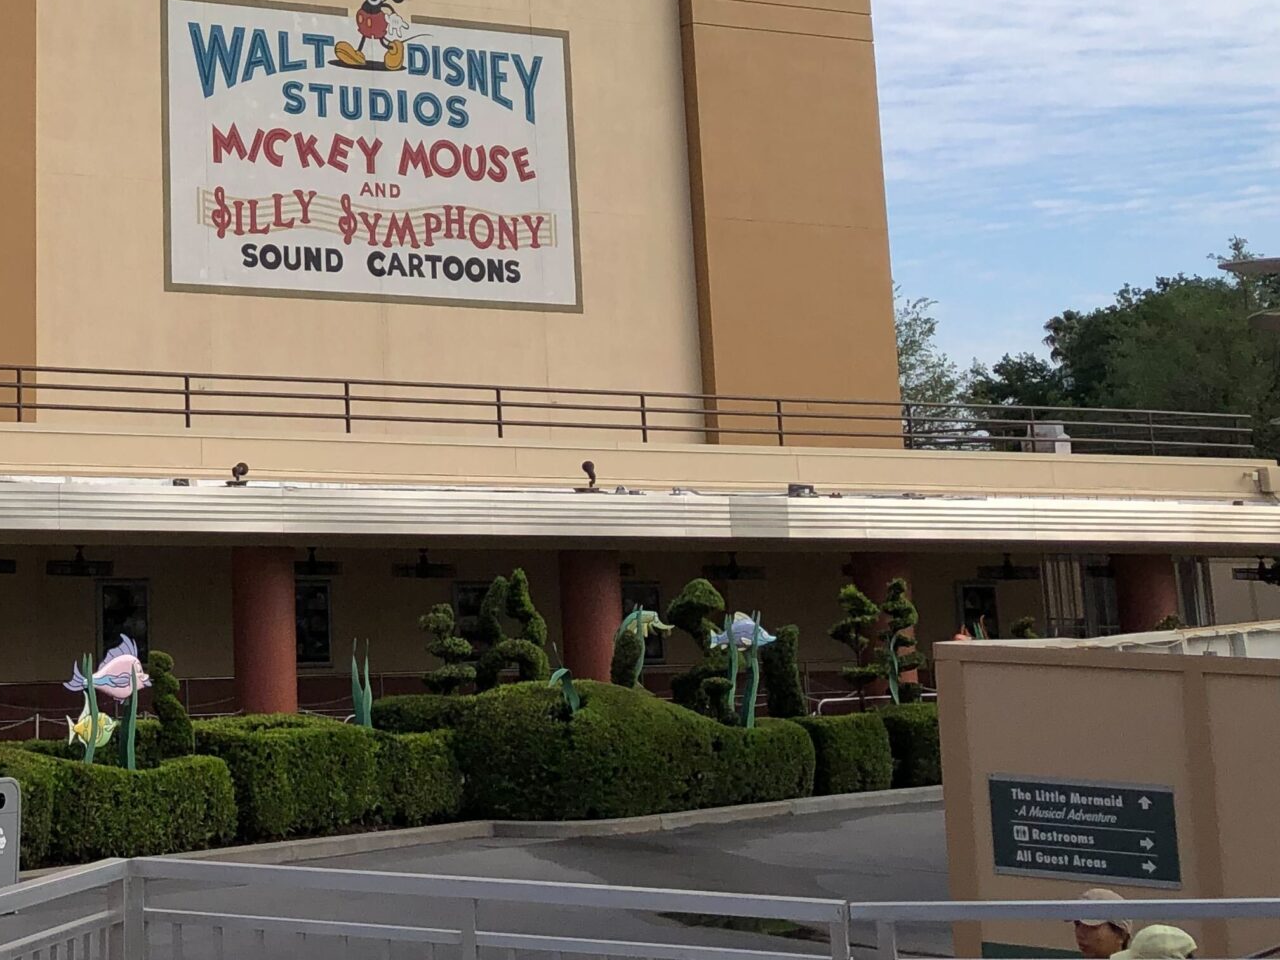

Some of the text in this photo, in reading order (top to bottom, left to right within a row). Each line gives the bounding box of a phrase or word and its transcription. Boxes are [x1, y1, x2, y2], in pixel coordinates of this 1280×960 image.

[188, 21, 544, 125] WALT DISNEY
[282, 81, 470, 128] STUDIOS
[212, 122, 536, 183] MICKEY MOUSE
[360, 182, 401, 198] AND
[211, 186, 545, 251] SILLY SYMPHONY
[242, 243, 521, 284] SOUND CARTOONS
[1011, 788, 1124, 808] The Little Mermaid
[1029, 806, 1065, 820] Musical
[1067, 808, 1118, 824] Adventure
[1032, 828, 1095, 845] Restrooms
[1016, 850, 1107, 869] All Guest Areas
